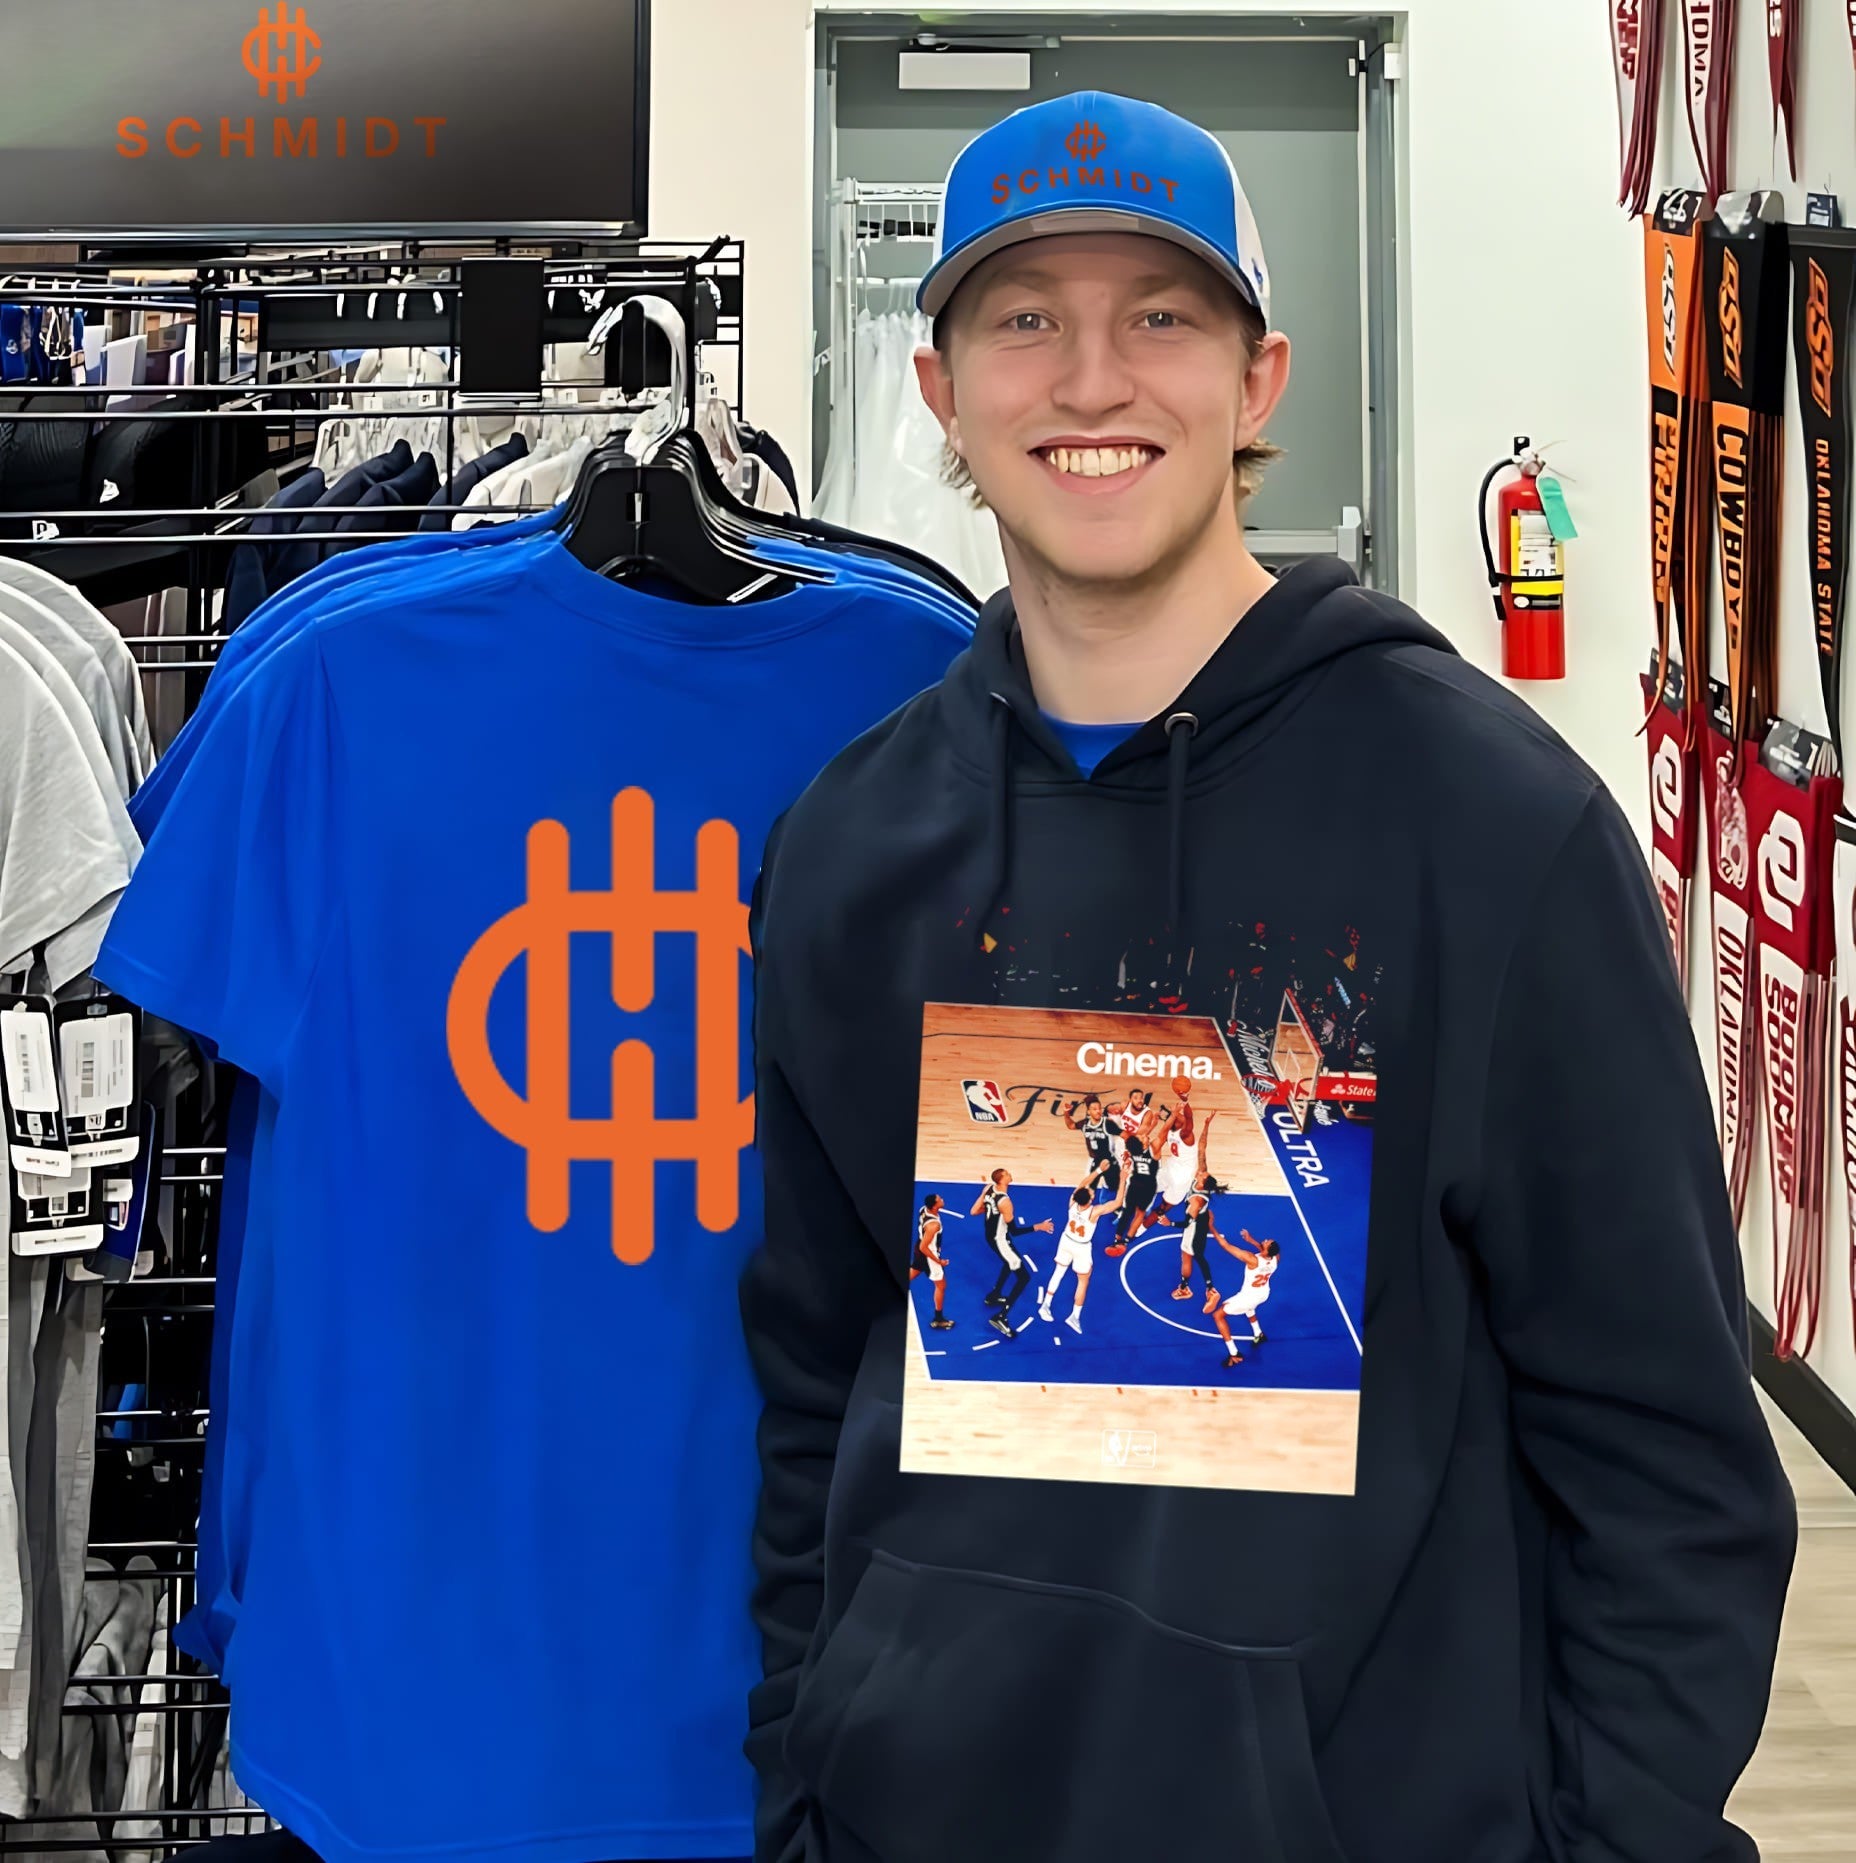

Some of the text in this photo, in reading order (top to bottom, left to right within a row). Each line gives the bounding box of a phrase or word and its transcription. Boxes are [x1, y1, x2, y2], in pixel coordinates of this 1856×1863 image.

[116, 116, 447, 159] SCHMIDT
[992, 166, 1179, 205] SCHMIDT
[1815, 439, 1831, 570] OKLAHOMA
[1718, 926, 1746, 1144] OKLAHOMA
[1076, 1041, 1222, 1081] Cinema.
[1347, 1084, 1372, 1097] State
[975, 1111, 995, 1122] NBA
[1272, 1111, 1330, 1189] ULTRA
